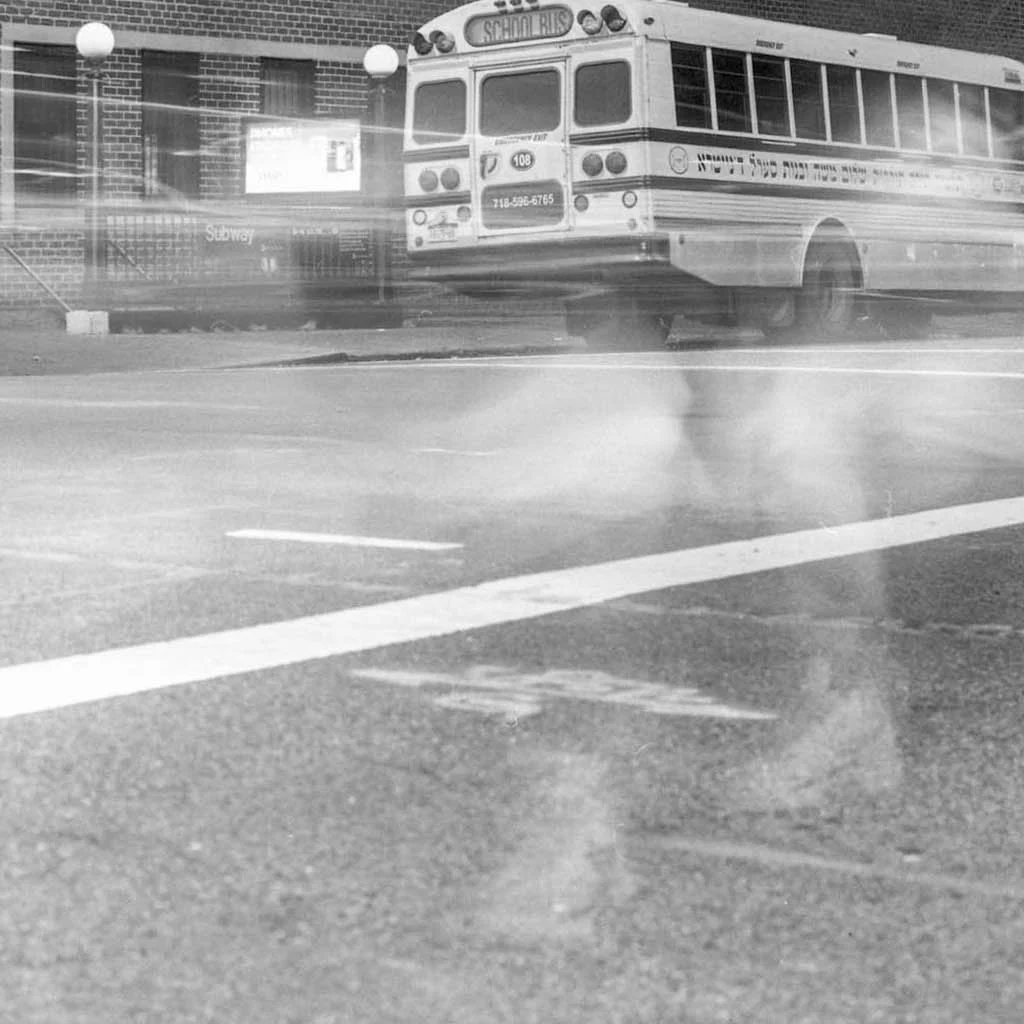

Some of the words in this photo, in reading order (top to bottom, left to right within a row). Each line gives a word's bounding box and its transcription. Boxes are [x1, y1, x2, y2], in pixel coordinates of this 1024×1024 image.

[483, 15, 534, 43] SCHOOL
[540, 10, 568, 36] BUS
[513, 154, 531, 166] 108
[491, 193, 554, 209] 718-596-6765
[205, 223, 255, 245] Subway
